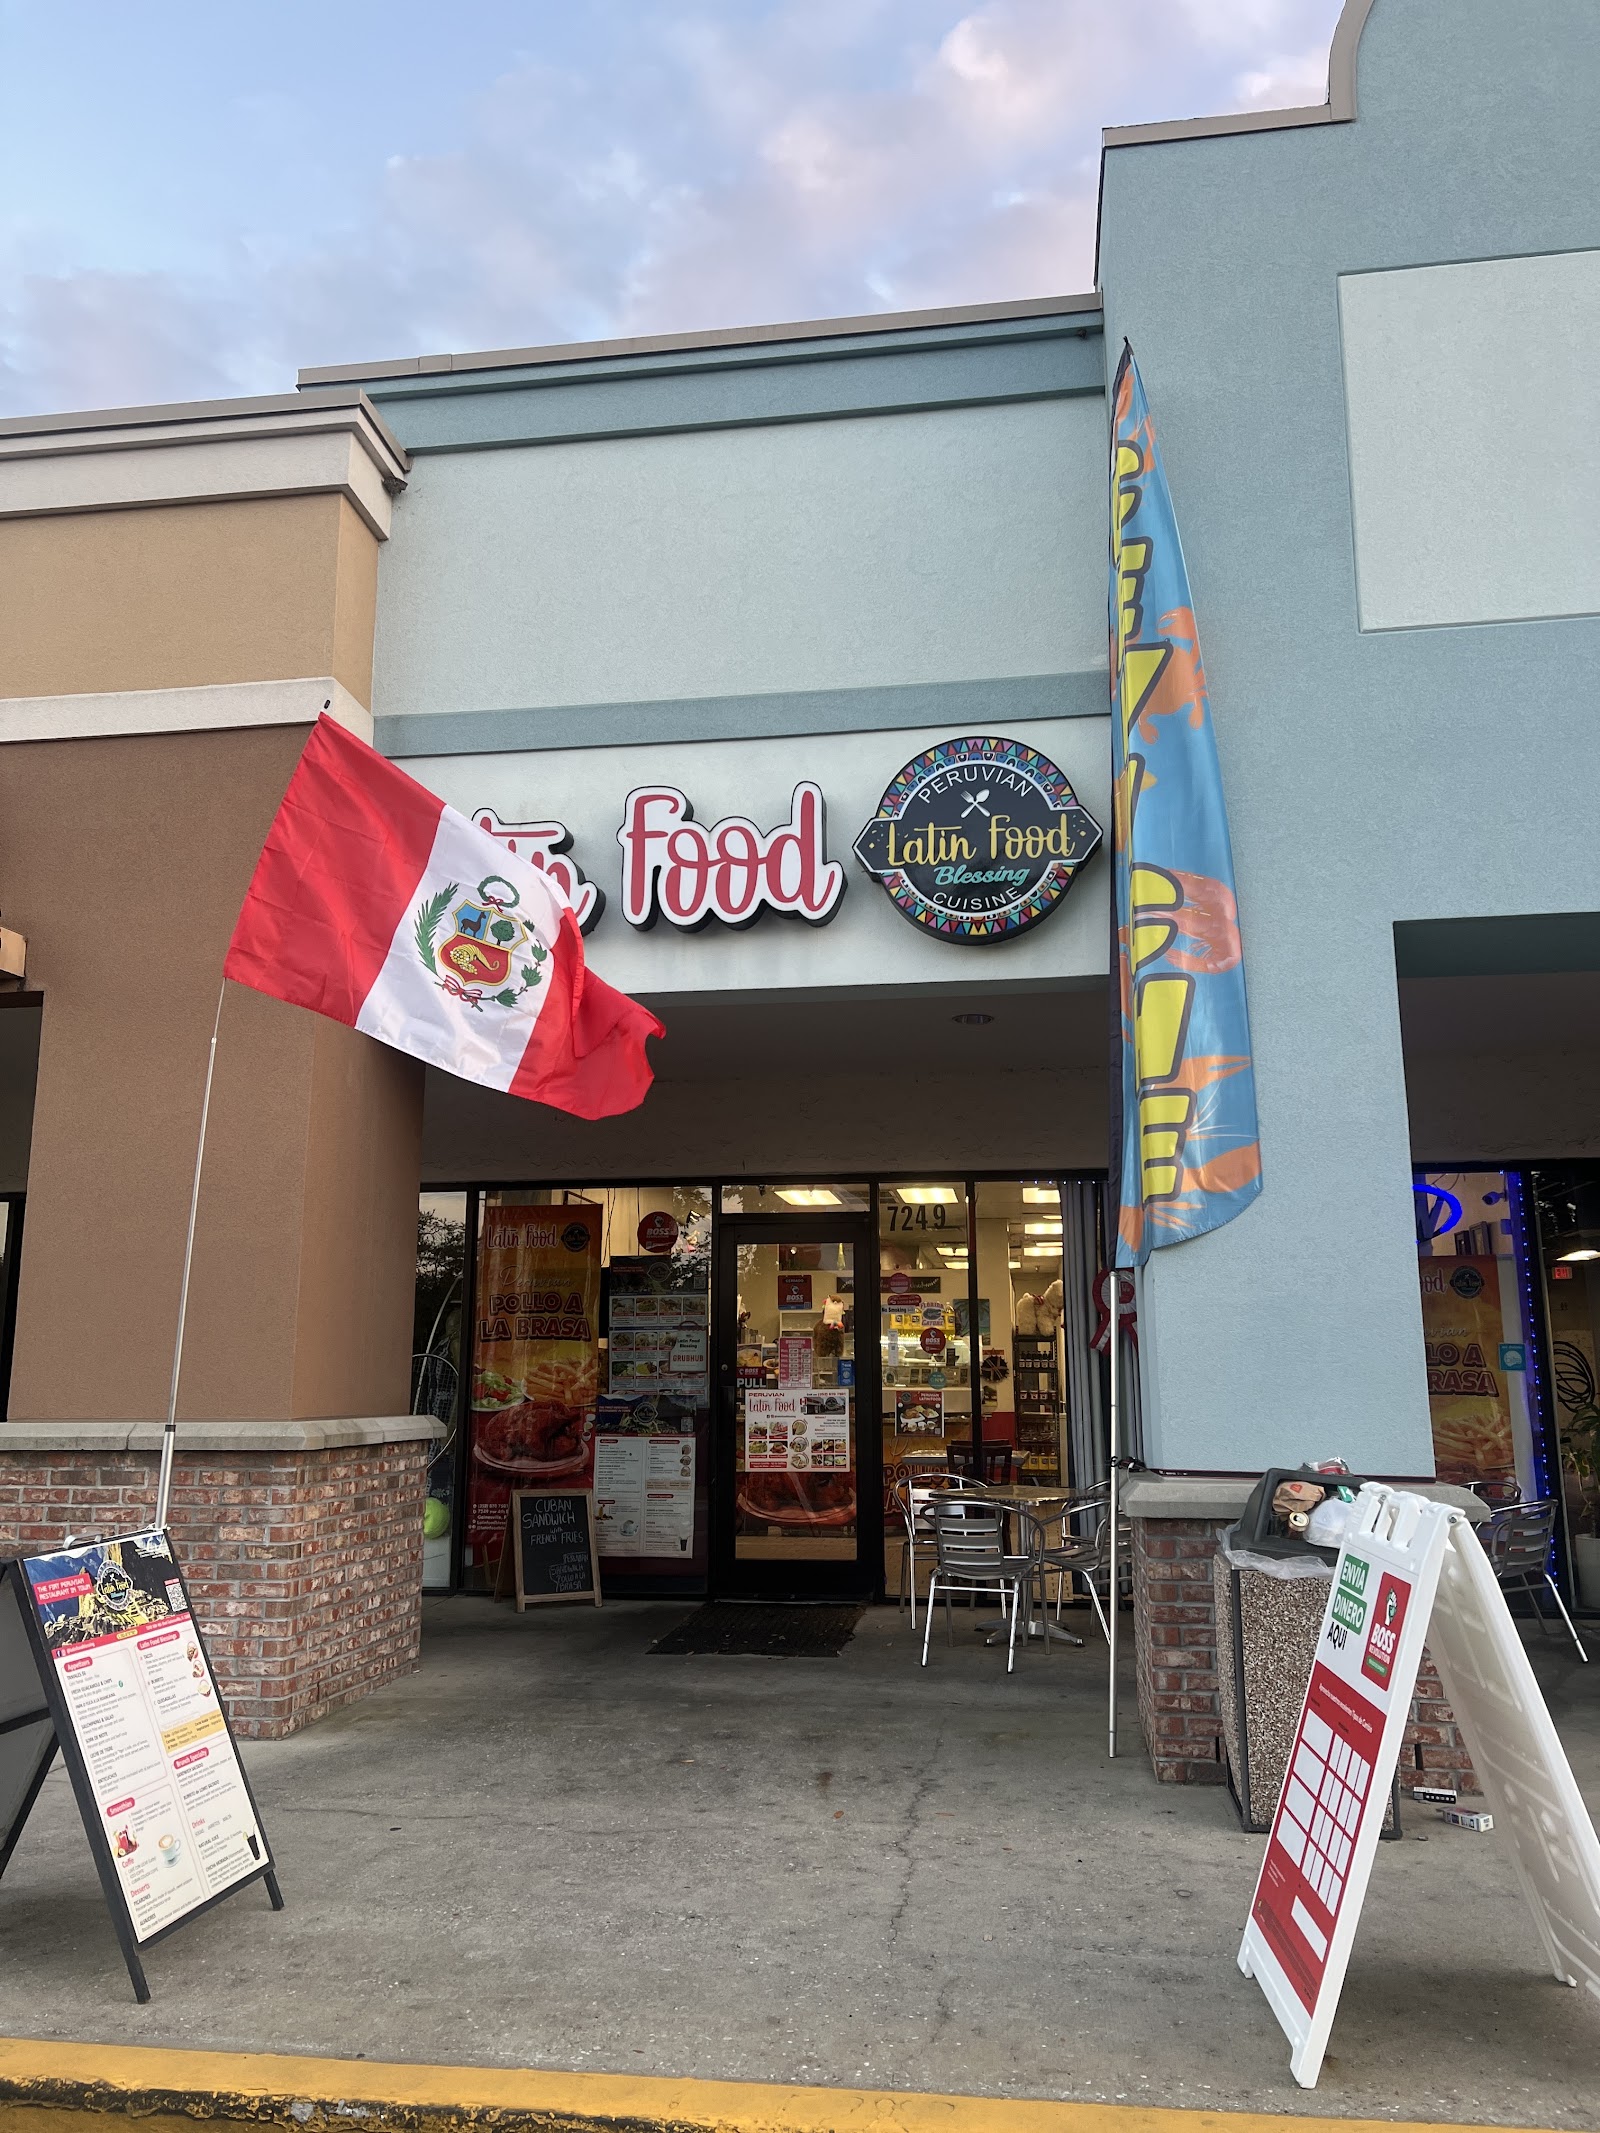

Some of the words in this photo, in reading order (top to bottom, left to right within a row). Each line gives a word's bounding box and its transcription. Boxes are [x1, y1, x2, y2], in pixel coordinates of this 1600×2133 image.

[918, 766, 1033, 804] PERUVIAN
[886, 821, 976, 867] Latin
[933, 864, 1031, 886] Blessing
[932, 886, 1022, 911] CUISINE
[887, 1204, 946, 1231] 7249
[487, 1225, 520, 1249] Latin
[646, 1228, 670, 1236] BOSS
[490, 1292, 562, 1316] POLLO
[564, 1292, 584, 1315] A
[480, 1317, 512, 1342] LA
[515, 1316, 592, 1342] BRASA
[672, 1354, 704, 1362] GRUBHUB
[1460, 1343, 1486, 1368] A
[736, 1377, 767, 1388] PULL
[1427, 1369, 1499, 1397] RASA
[535, 1499, 572, 1513] CUBAN
[522, 1512, 576, 1529] SANDWICH
[530, 1534, 557, 1546] FRENCH
[560, 1531, 584, 1544] FRIES
[1341, 1561, 1366, 1591] ENVÍA
[37, 1585, 47, 1593] THE
[1333, 1593, 1364, 1629] DINERO
[1326, 1621, 1350, 1651] AQUÍ
[1370, 1622, 1397, 1654] BOSS
[191, 1817, 205, 1829] Drinks
[130, 1881, 150, 1897] Desserts
